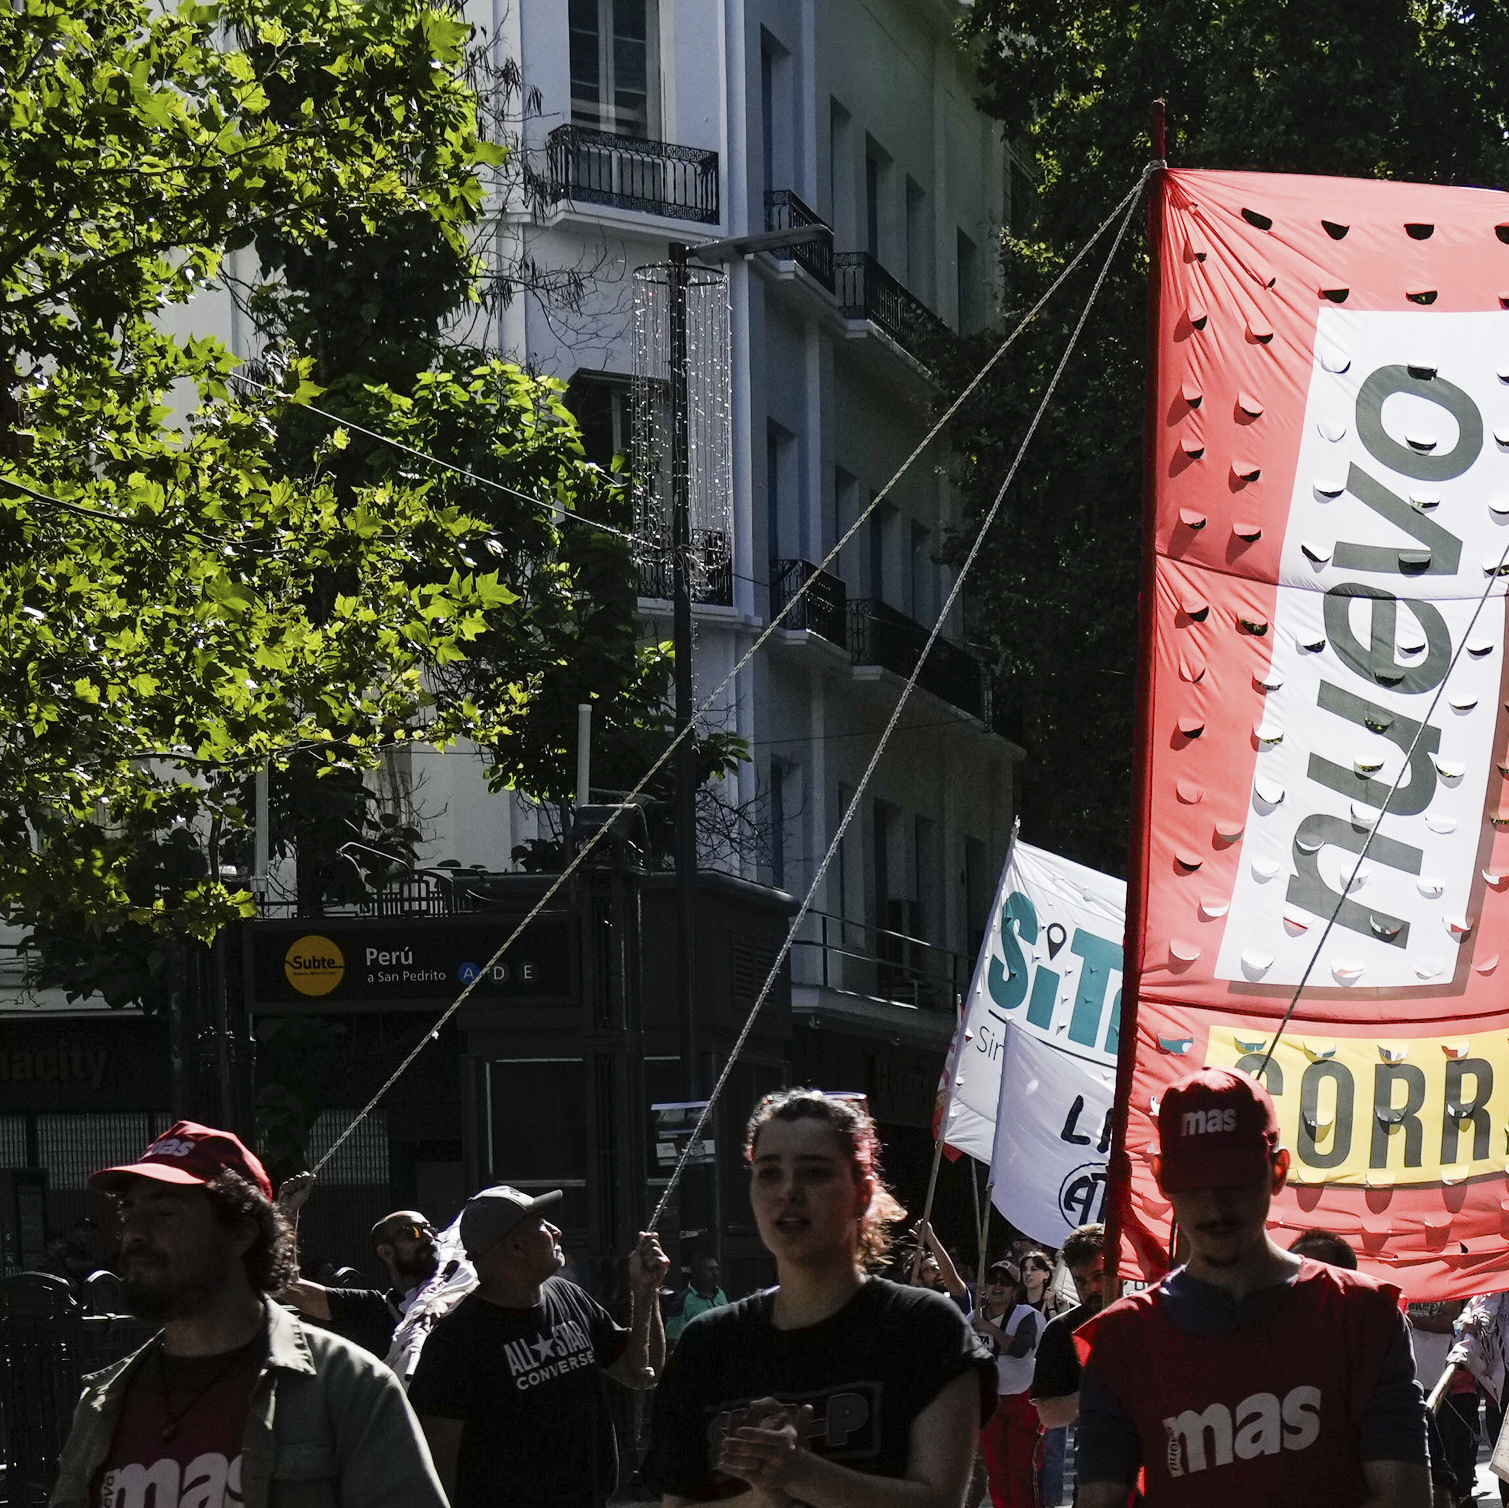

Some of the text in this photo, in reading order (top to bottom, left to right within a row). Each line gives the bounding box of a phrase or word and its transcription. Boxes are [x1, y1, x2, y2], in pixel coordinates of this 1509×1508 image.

[1283, 362, 1483, 948] nuevo
[292, 955, 336, 970] Subte
[365, 946, 413, 966] Perú
[367, 970, 447, 983] a San Pedrito
[463, 965, 533, 980] A D E
[1181, 1108, 1237, 1137] mas
[503, 1320, 591, 1377] ALL STAR
[516, 1350, 595, 1390] CONVERSE
[1162, 1385, 1322, 1478] mas
